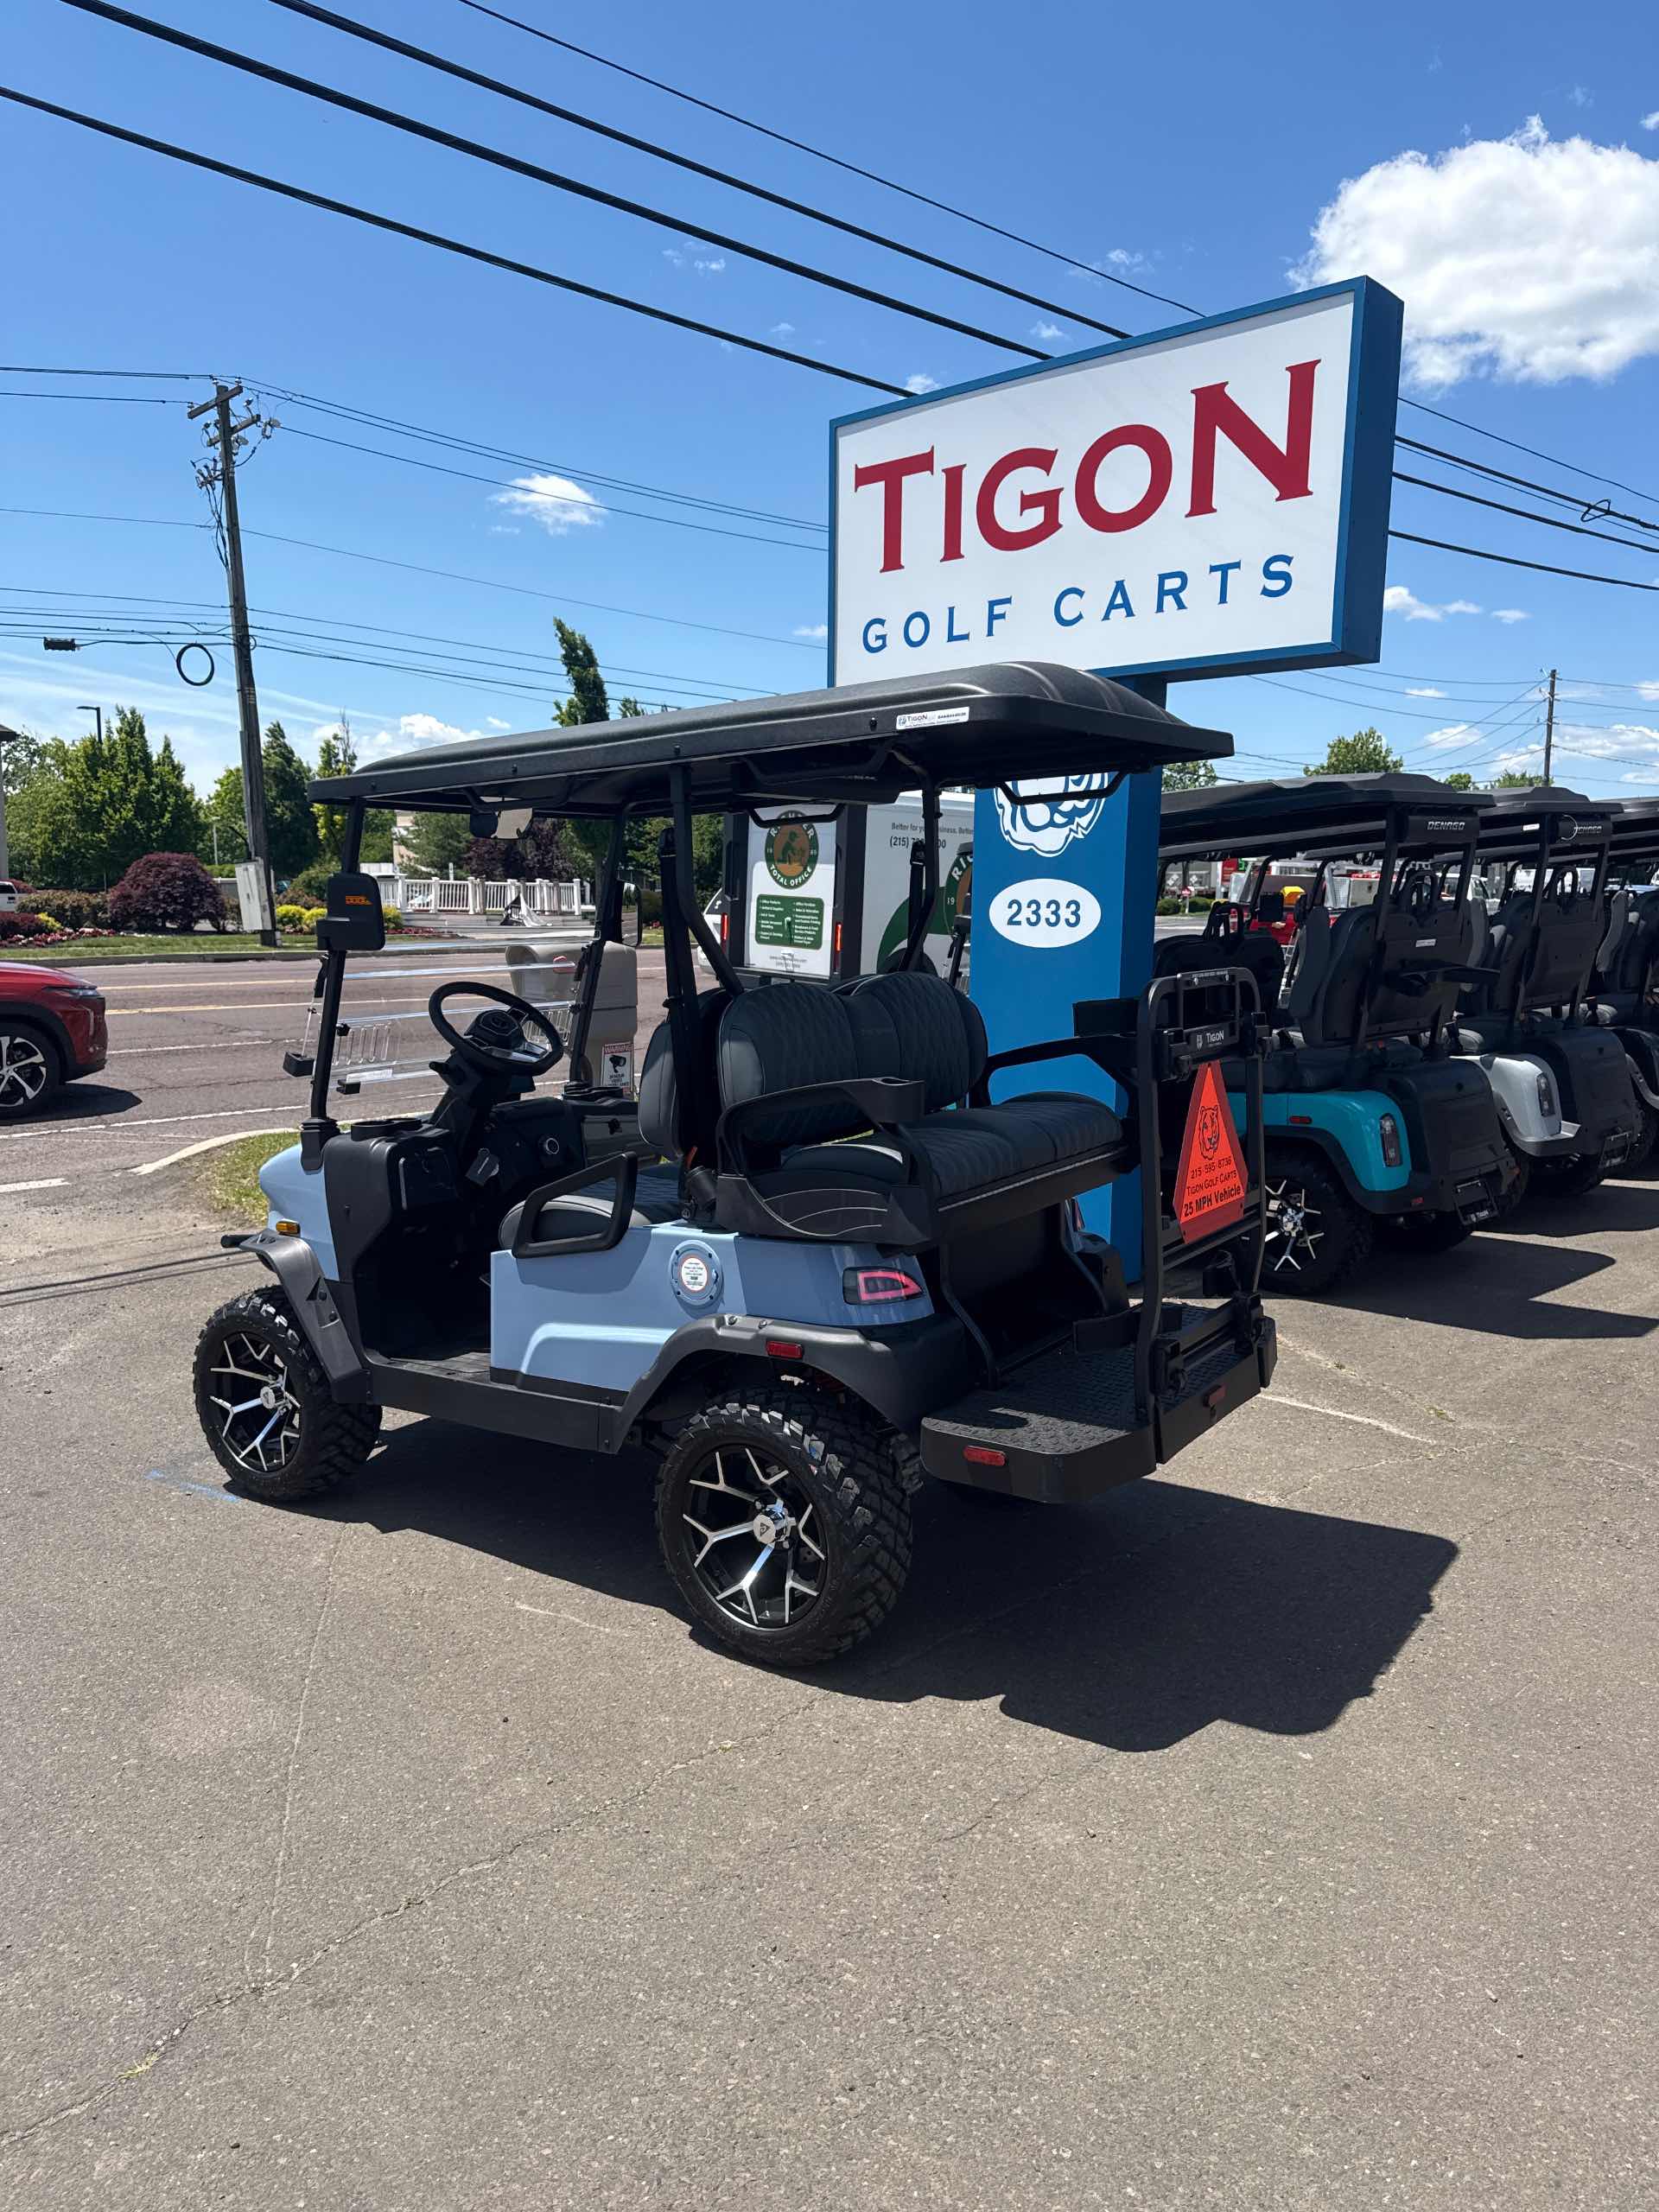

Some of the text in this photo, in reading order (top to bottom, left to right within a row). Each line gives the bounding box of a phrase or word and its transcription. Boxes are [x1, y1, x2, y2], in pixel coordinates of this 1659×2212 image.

[855, 359, 1320, 572] TIGON
[862, 554, 1294, 654] GOLF CARTS
[889, 836, 910, 849] (215)
[769, 864, 812, 887] TOTAL OFFICE
[1007, 899, 1082, 928] 2333
[1206, 1030, 1224, 1043] TIGON
[1184, 1184, 1241, 1217] 25 MPH Vehicle
